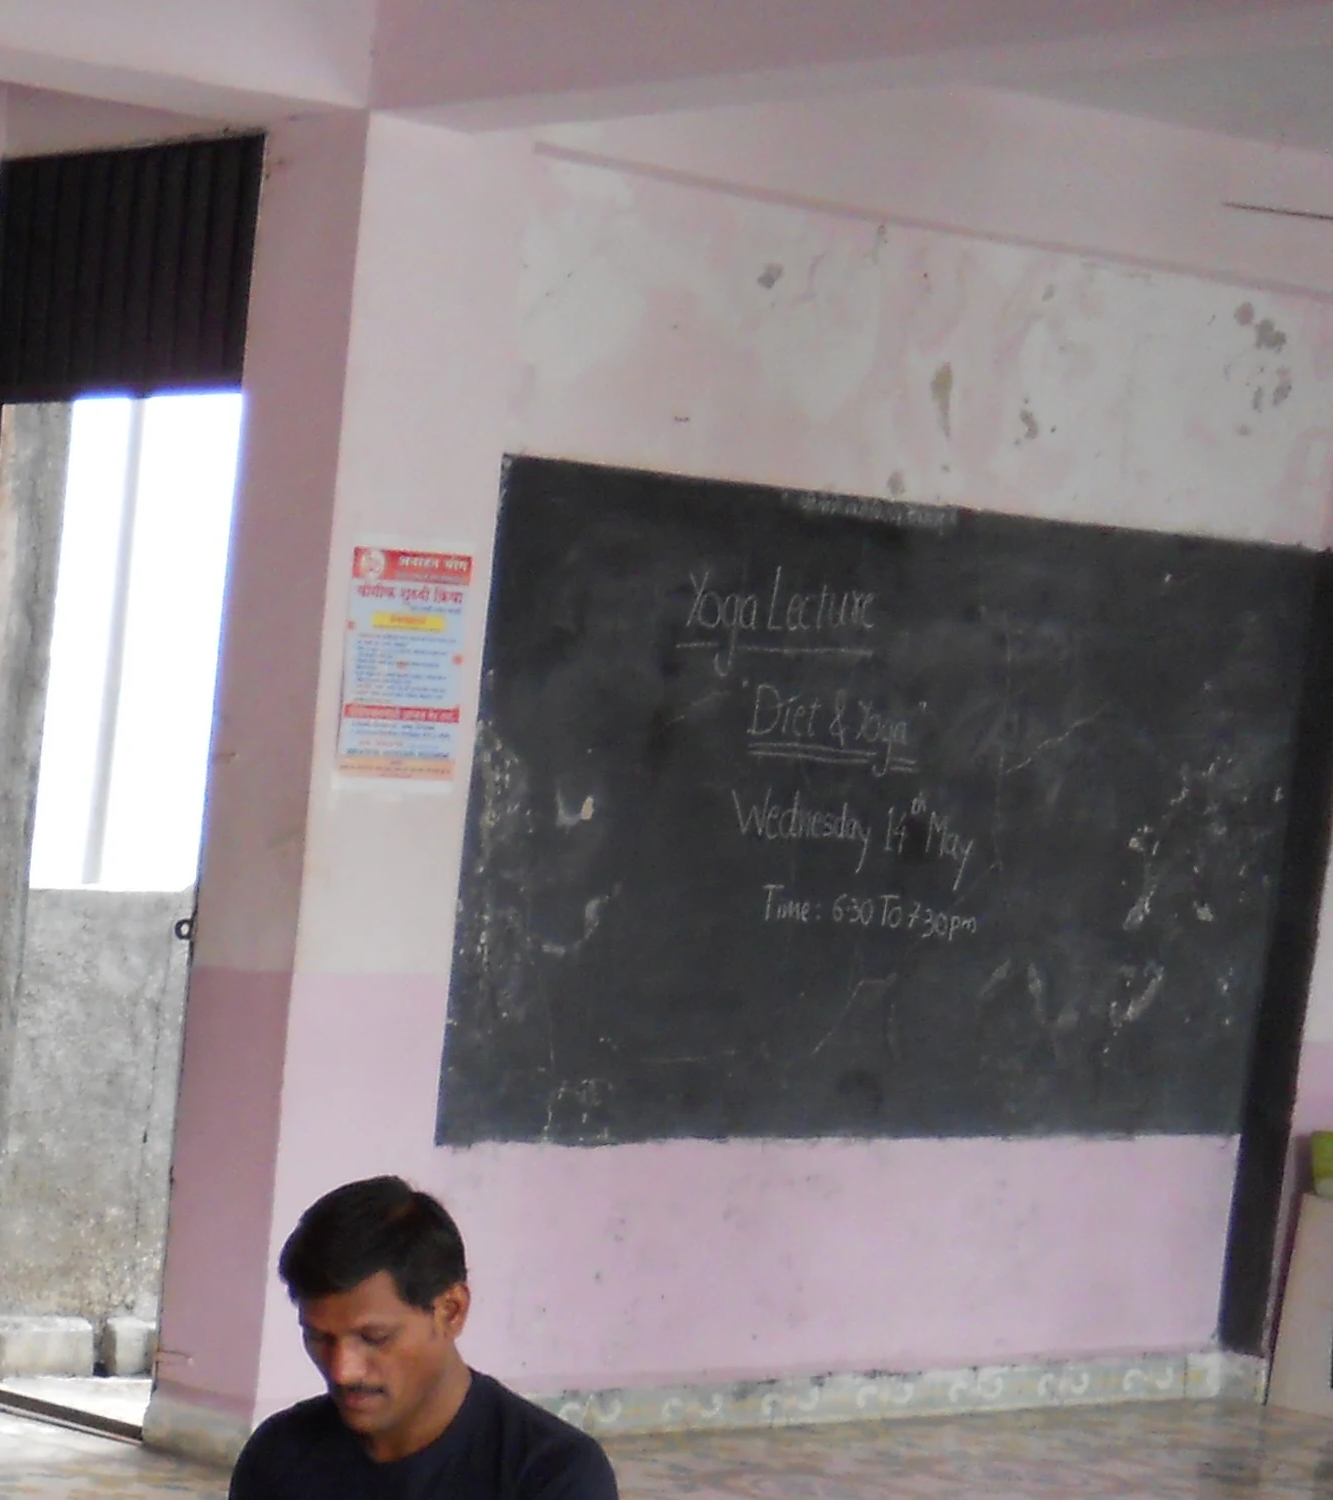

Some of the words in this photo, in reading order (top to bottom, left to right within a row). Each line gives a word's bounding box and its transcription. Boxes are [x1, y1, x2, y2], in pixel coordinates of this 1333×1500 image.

[685, 570, 759, 678] Yoga
[767, 564, 876, 632] Lecture
[732, 788, 872, 874] Wednesday
[925, 810, 974, 892] May
